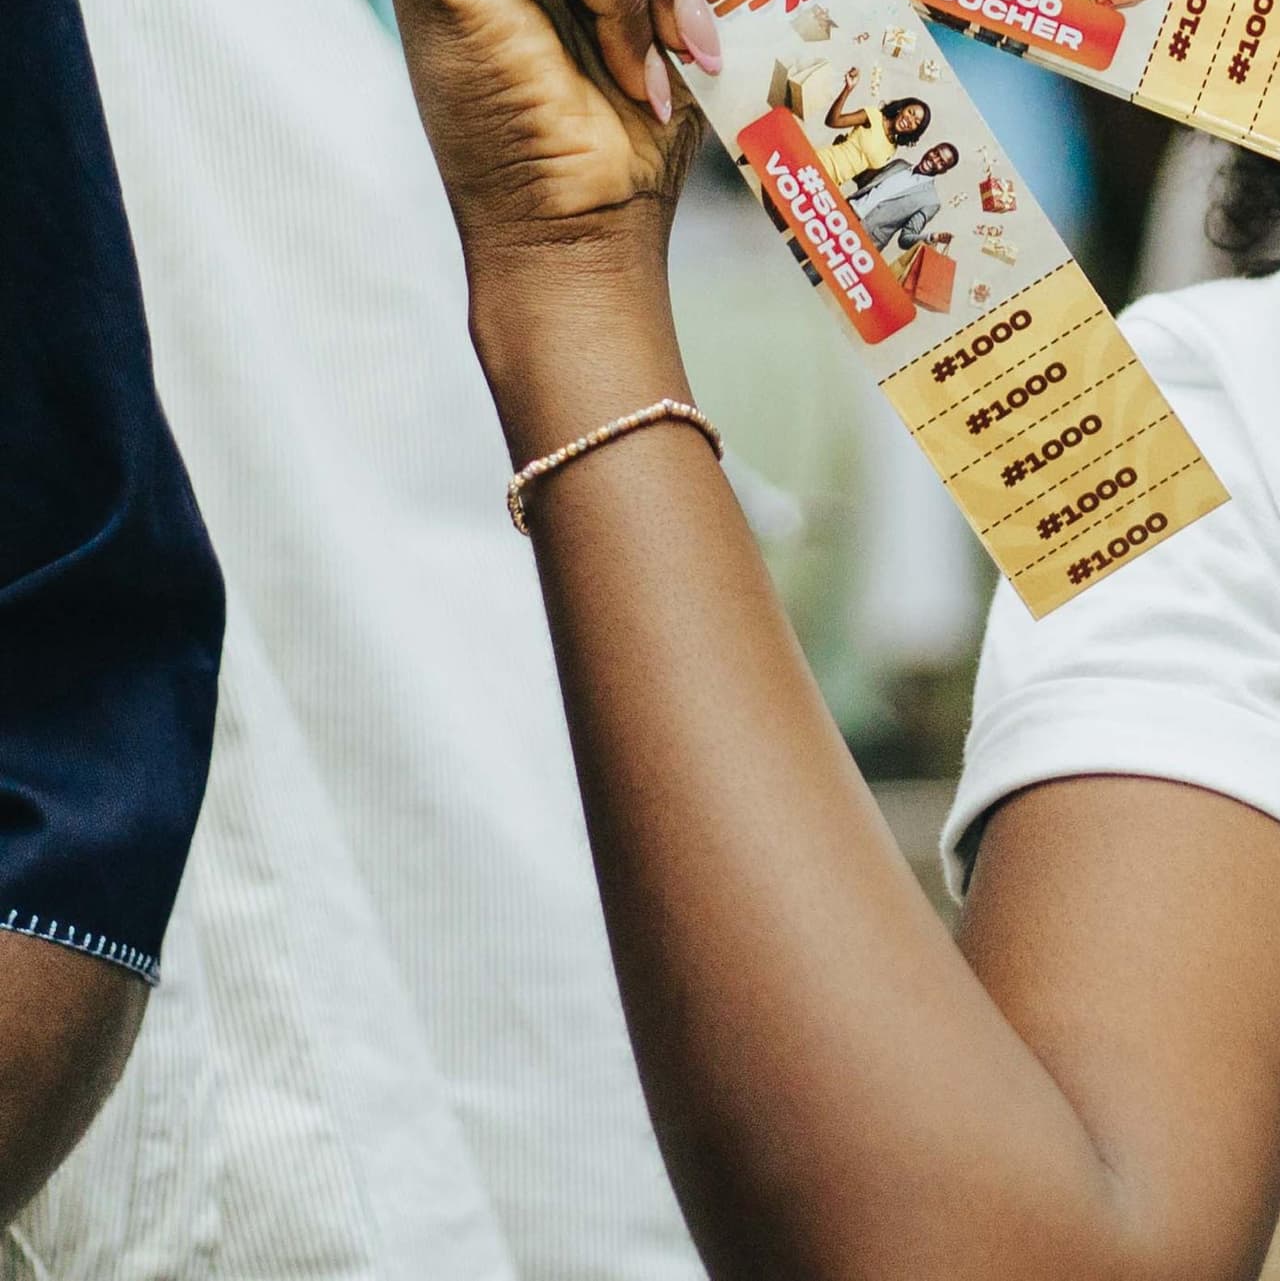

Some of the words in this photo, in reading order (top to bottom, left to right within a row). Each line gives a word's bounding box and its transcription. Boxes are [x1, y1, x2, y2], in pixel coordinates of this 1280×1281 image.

[764, 150, 873, 316] VOUCHER
[795, 165, 876, 275] #5000
[930, 308, 1033, 385] #1000
[965, 360, 1068, 436] #1000
[999, 414, 1103, 489] #1000
[1035, 465, 1139, 541] #1000
[1065, 511, 1169, 586] #1000
